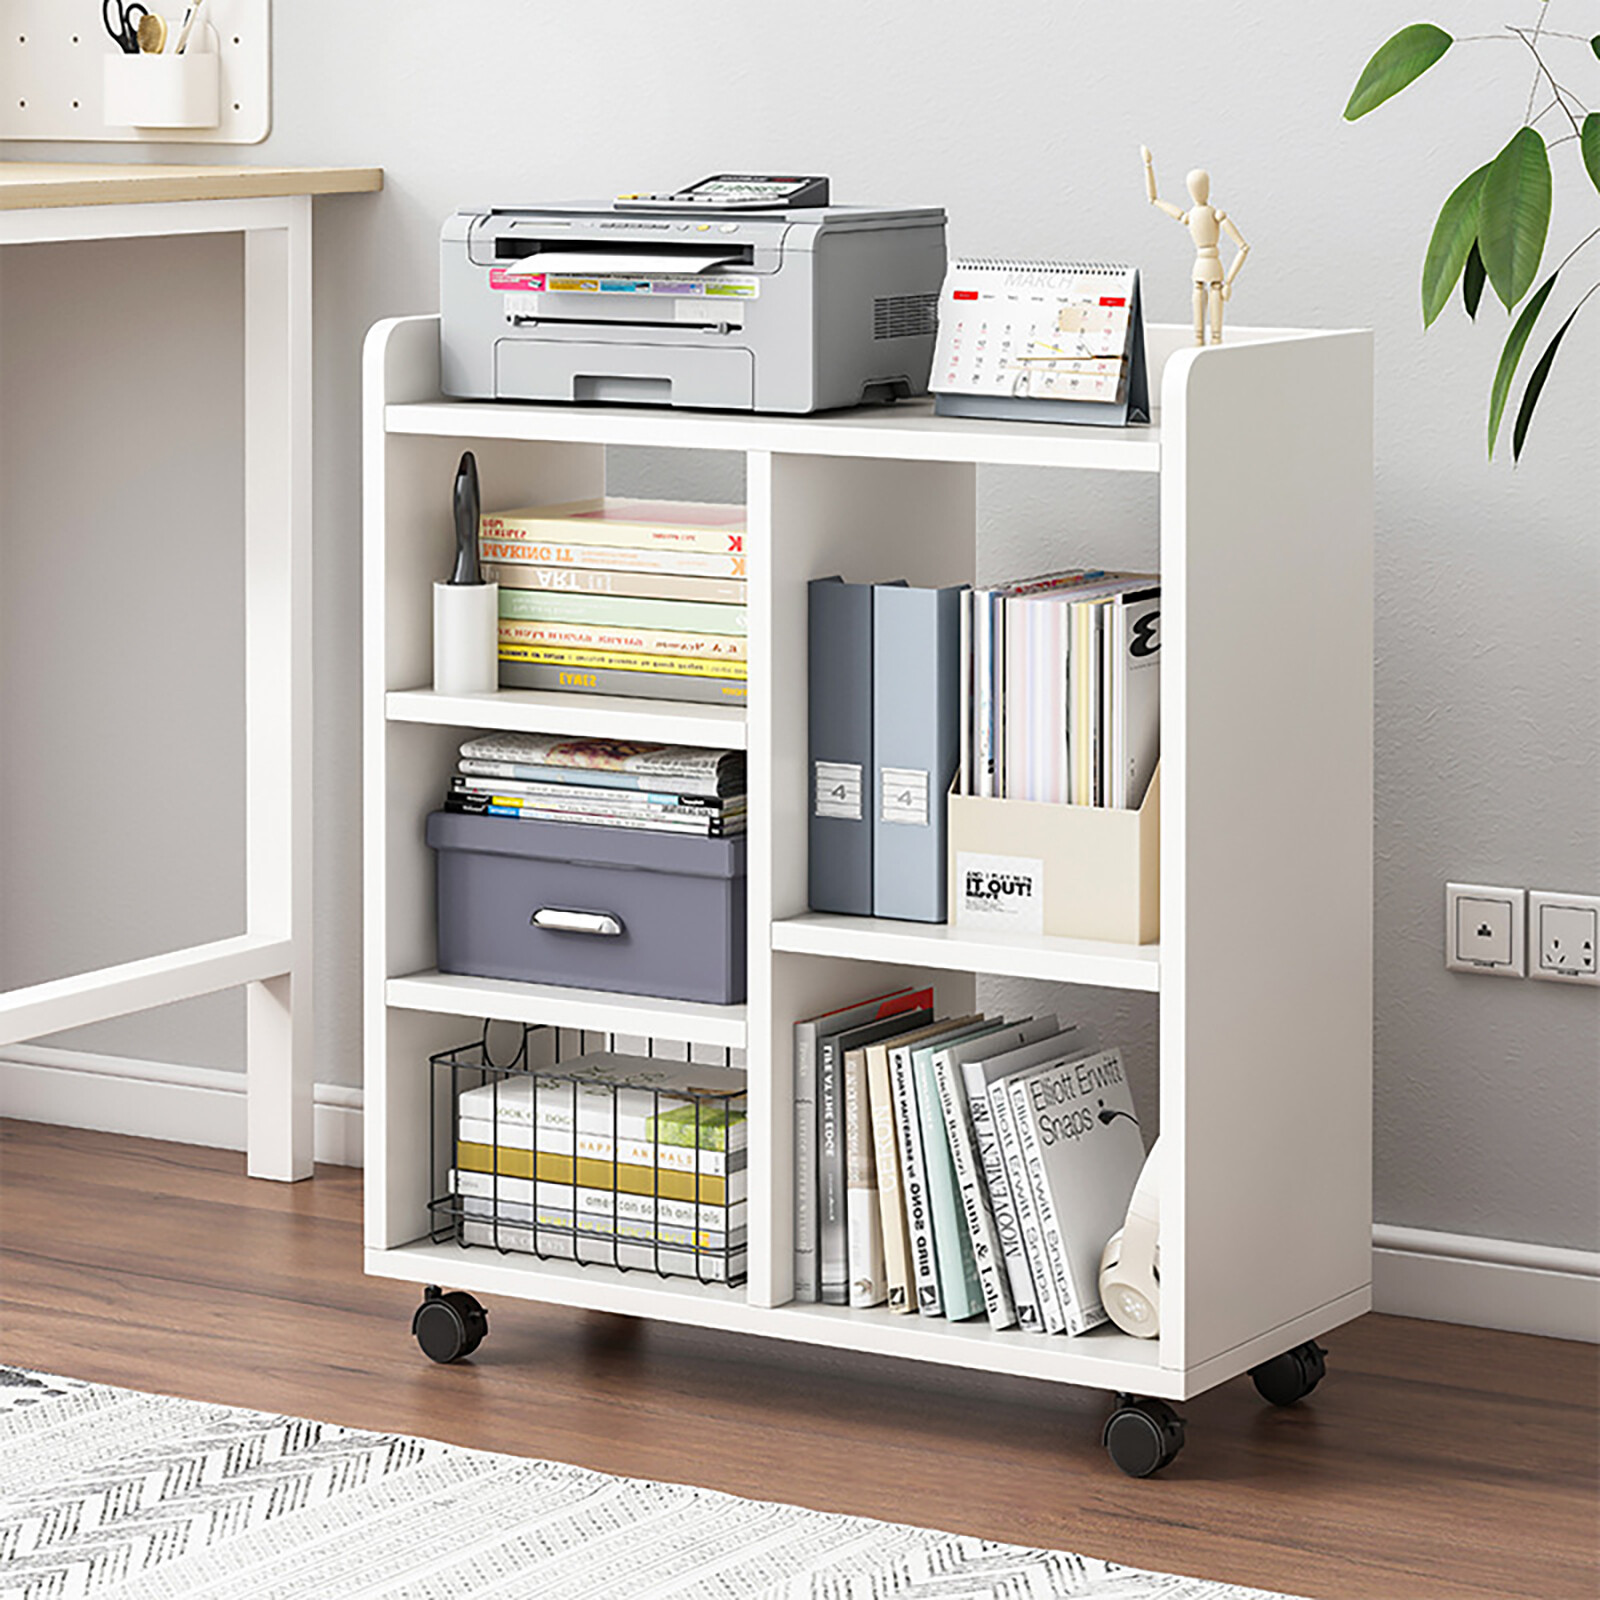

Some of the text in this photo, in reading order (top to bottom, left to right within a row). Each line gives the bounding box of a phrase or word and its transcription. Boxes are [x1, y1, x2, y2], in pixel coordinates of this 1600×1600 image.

[832, 784, 846, 800] 4
[897, 790, 912, 806] 4
[966, 878, 984, 892] IT
[987, 879, 1032, 897] OUT!
[1038, 1107, 1094, 1146] Snaps
[579, 1141, 693, 1165] HAPP ANMALS
[963, 1182, 981, 1236] Luna
[992, 1086, 1051, 1304] Elliott Erwitt Snaps
[1013, 1088, 1072, 1307] Elliott Erwitt Snaps
[975, 1242, 990, 1260] &
[981, 1266, 1000, 1315] Lola
